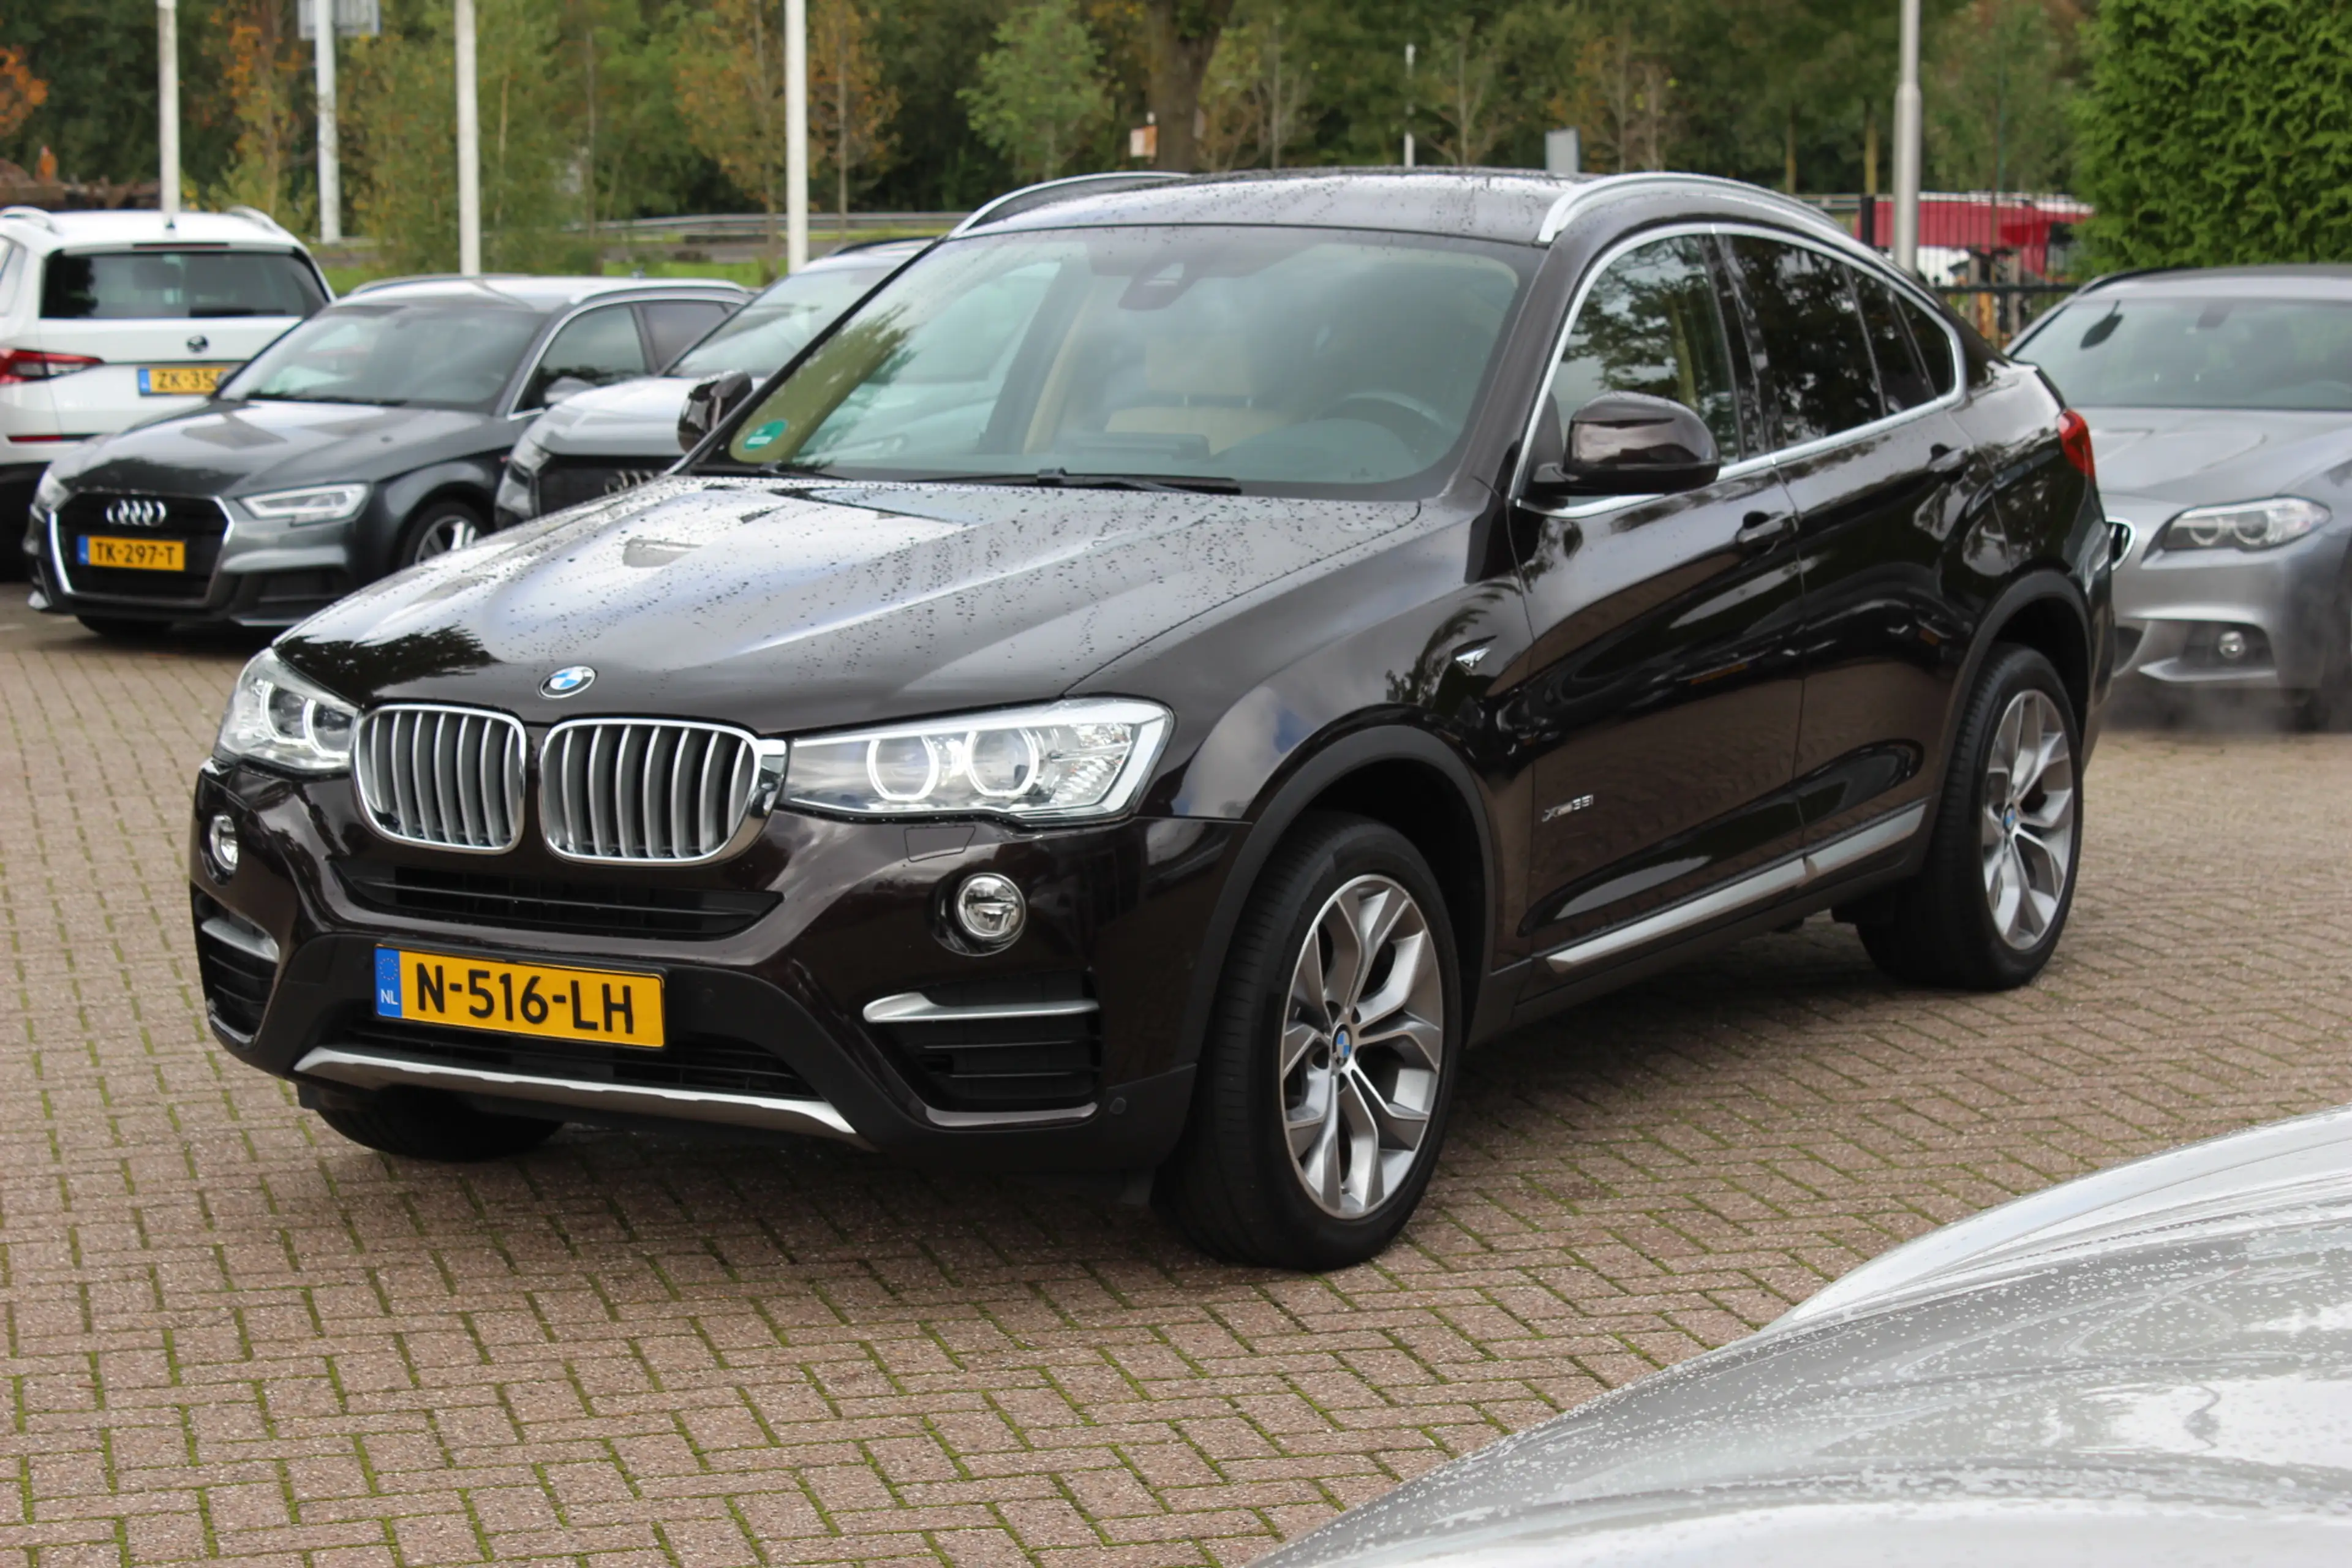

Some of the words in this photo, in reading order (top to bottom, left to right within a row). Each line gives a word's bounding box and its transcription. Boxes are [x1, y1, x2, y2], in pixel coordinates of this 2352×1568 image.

[157, 371, 220, 388] ZK-35
[96, 541, 175, 566] TK-297-T
[380, 989, 399, 1005] NL
[416, 962, 635, 1035] N-516-LH
